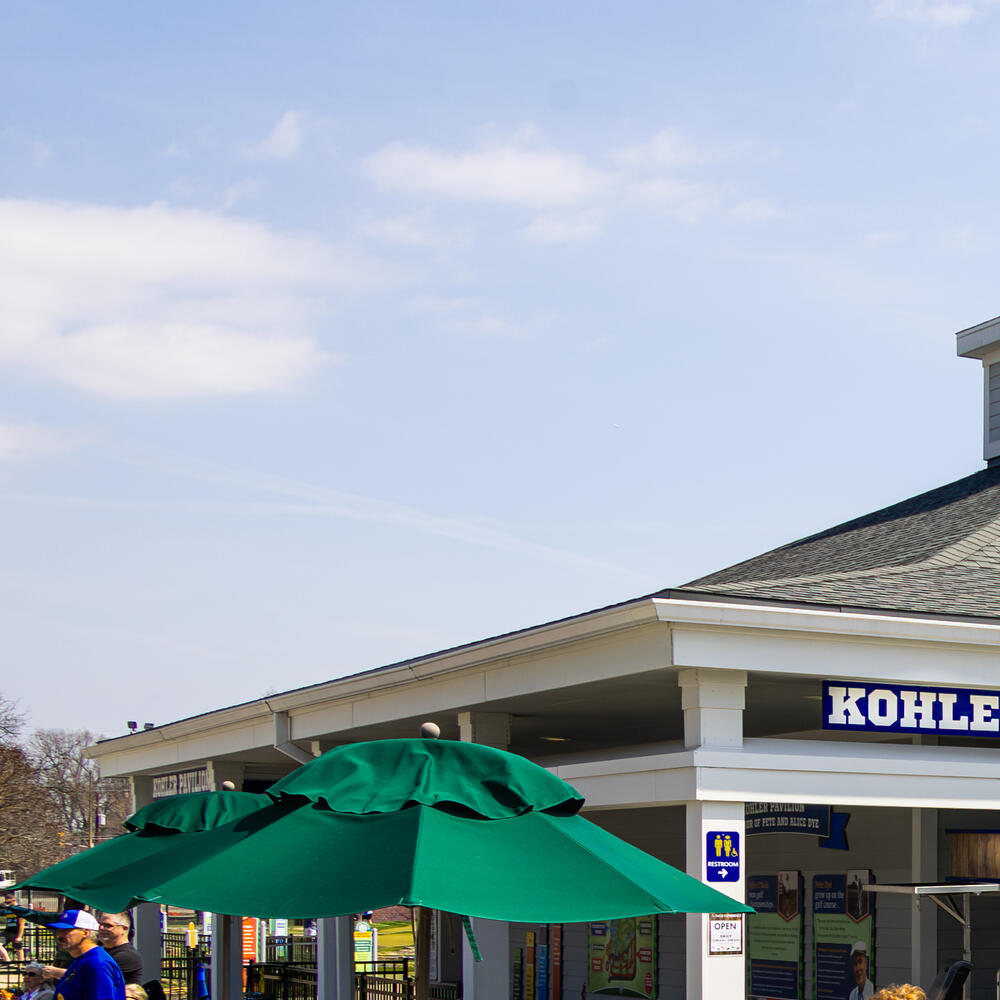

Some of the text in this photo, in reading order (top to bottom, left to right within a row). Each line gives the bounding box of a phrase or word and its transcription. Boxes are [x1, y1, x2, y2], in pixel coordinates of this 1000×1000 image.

[762, 818, 776, 827] PETE
[777, 817, 788, 826] AND
[790, 817, 806, 827] ALICE
[807, 818, 820, 828] DYE
[714, 922, 737, 930] OPEN
